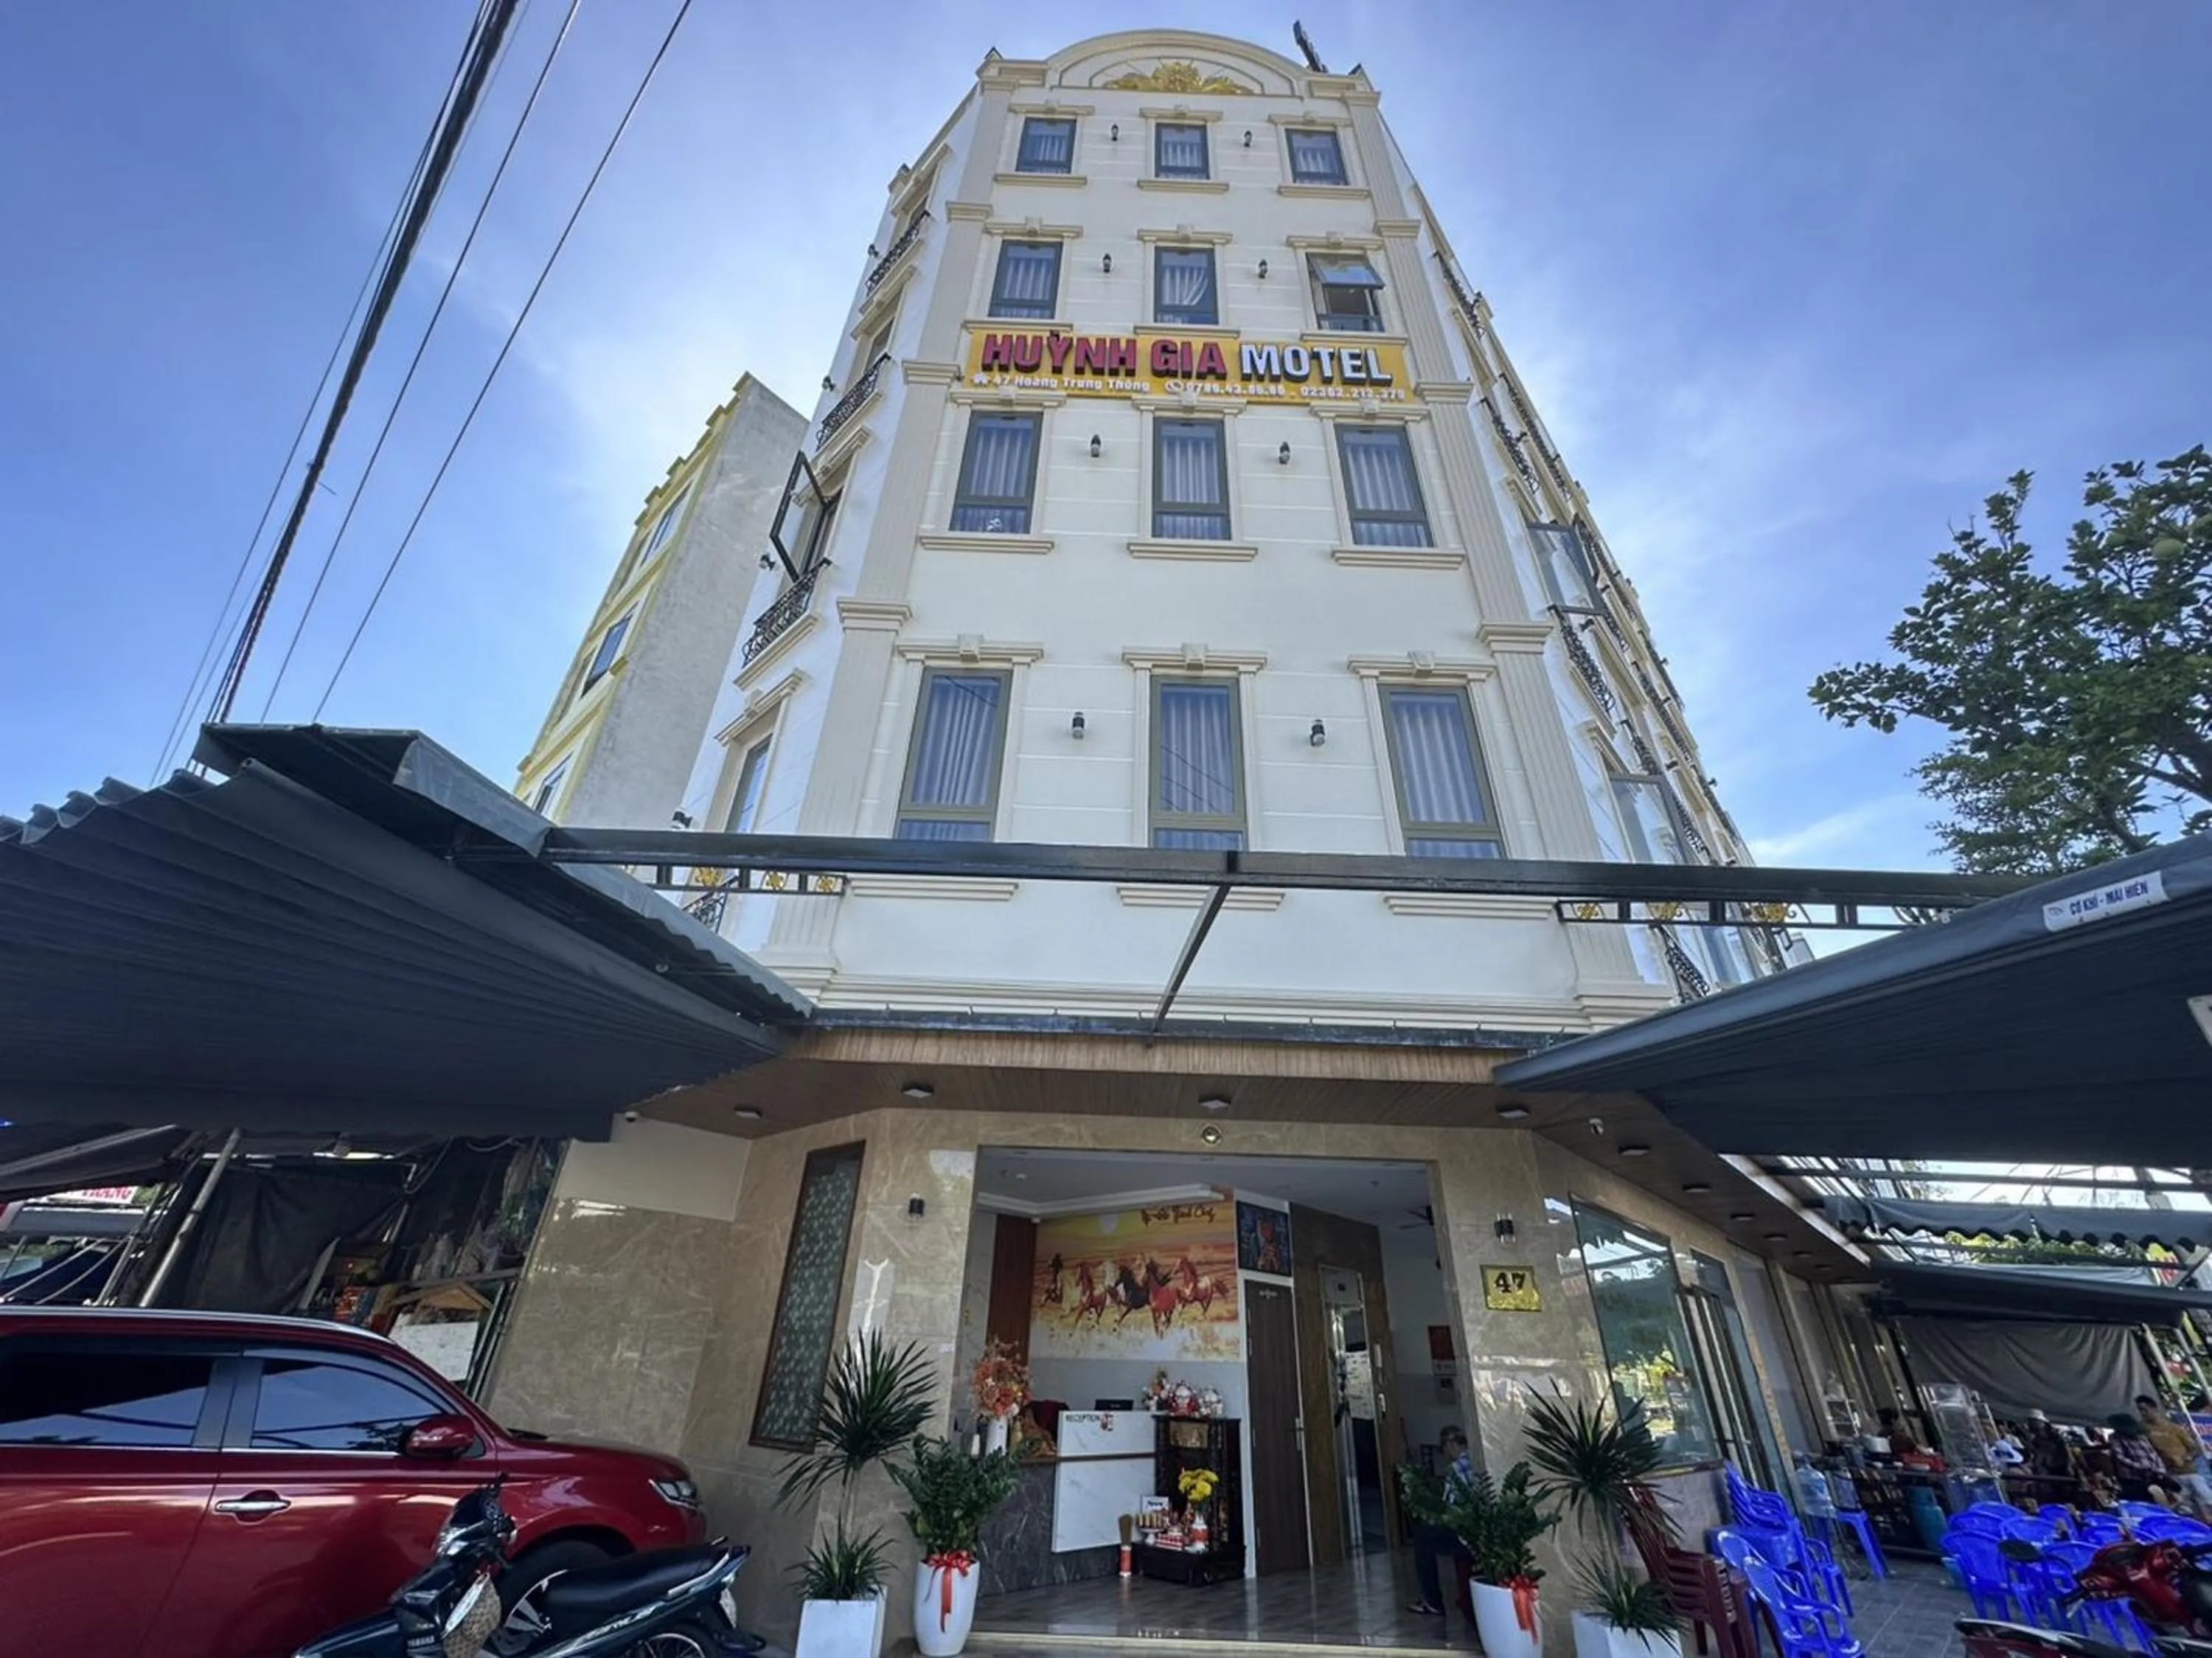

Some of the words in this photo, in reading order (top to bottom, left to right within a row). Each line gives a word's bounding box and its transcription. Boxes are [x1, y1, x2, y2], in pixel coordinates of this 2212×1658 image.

[981, 330, 1136, 375] HUỲNH
[1151, 339, 1227, 380] GIA
[1239, 342, 1393, 386] MOTEL
[1495, 1272, 1526, 1293] 47
